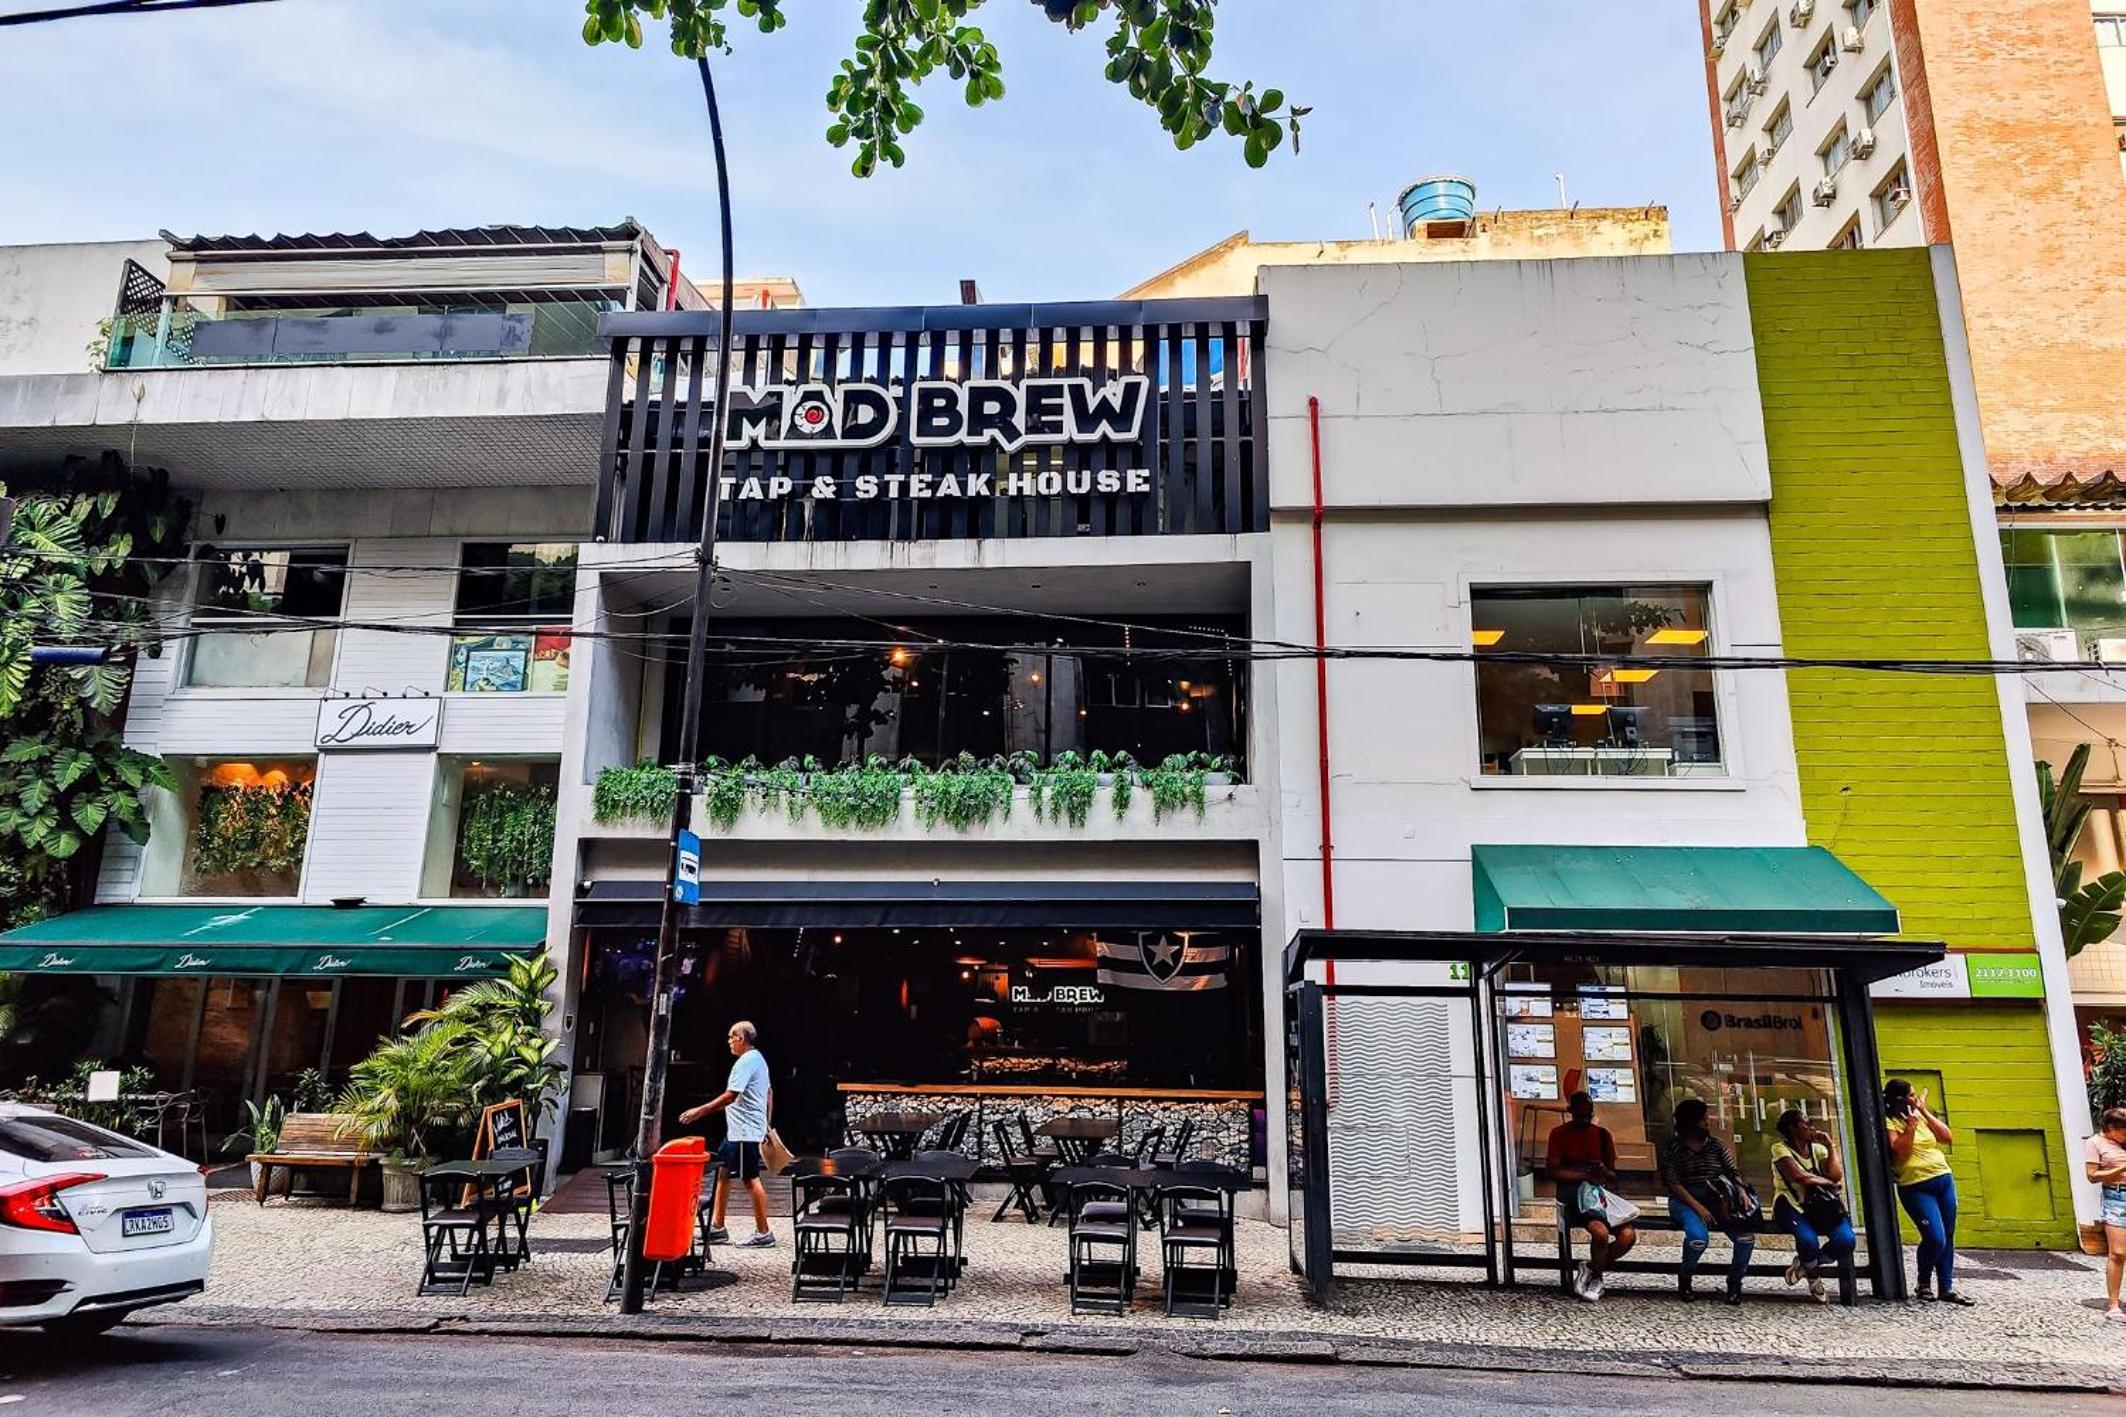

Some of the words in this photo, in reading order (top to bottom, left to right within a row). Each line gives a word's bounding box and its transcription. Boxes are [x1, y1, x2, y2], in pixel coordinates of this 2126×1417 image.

[724, 382, 898, 448] MAD
[910, 375, 1149, 454] BREW
[719, 475, 794, 500] TAP
[811, 474, 837, 499] &
[856, 472, 992, 500] STEAK
[1008, 468, 1151, 497] HOUSE
[320, 701, 434, 744] Didier
[1899, 965, 1951, 979] brokers
[1054, 985, 1104, 1004] BREW
